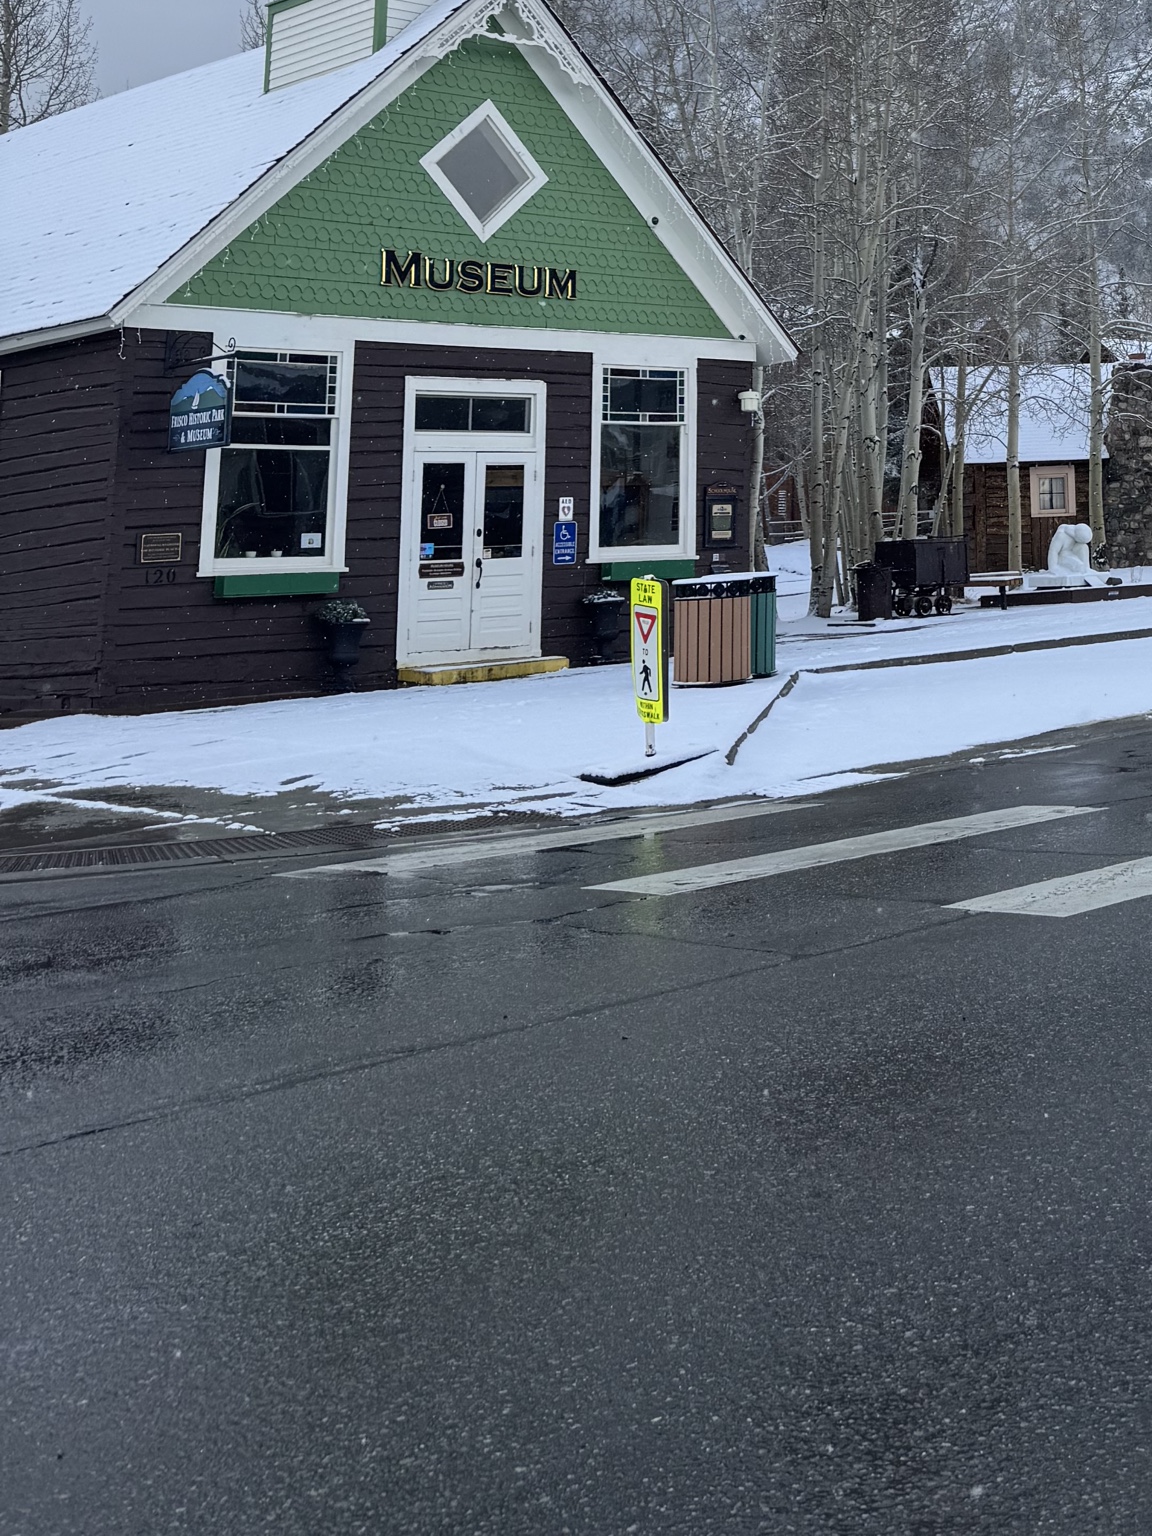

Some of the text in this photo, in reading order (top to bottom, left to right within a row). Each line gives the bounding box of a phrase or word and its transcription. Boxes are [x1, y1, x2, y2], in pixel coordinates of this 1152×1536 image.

[380, 248, 577, 300] MUSEUM
[171, 408, 225, 429] FRISCO HISTORIC PARK
[180, 427, 213, 444] & MUSEUM
[145, 567, 177, 585] 120
[636, 582, 656, 595] STATE
[638, 594, 653, 605] LAW
[642, 648, 649, 656] TO
